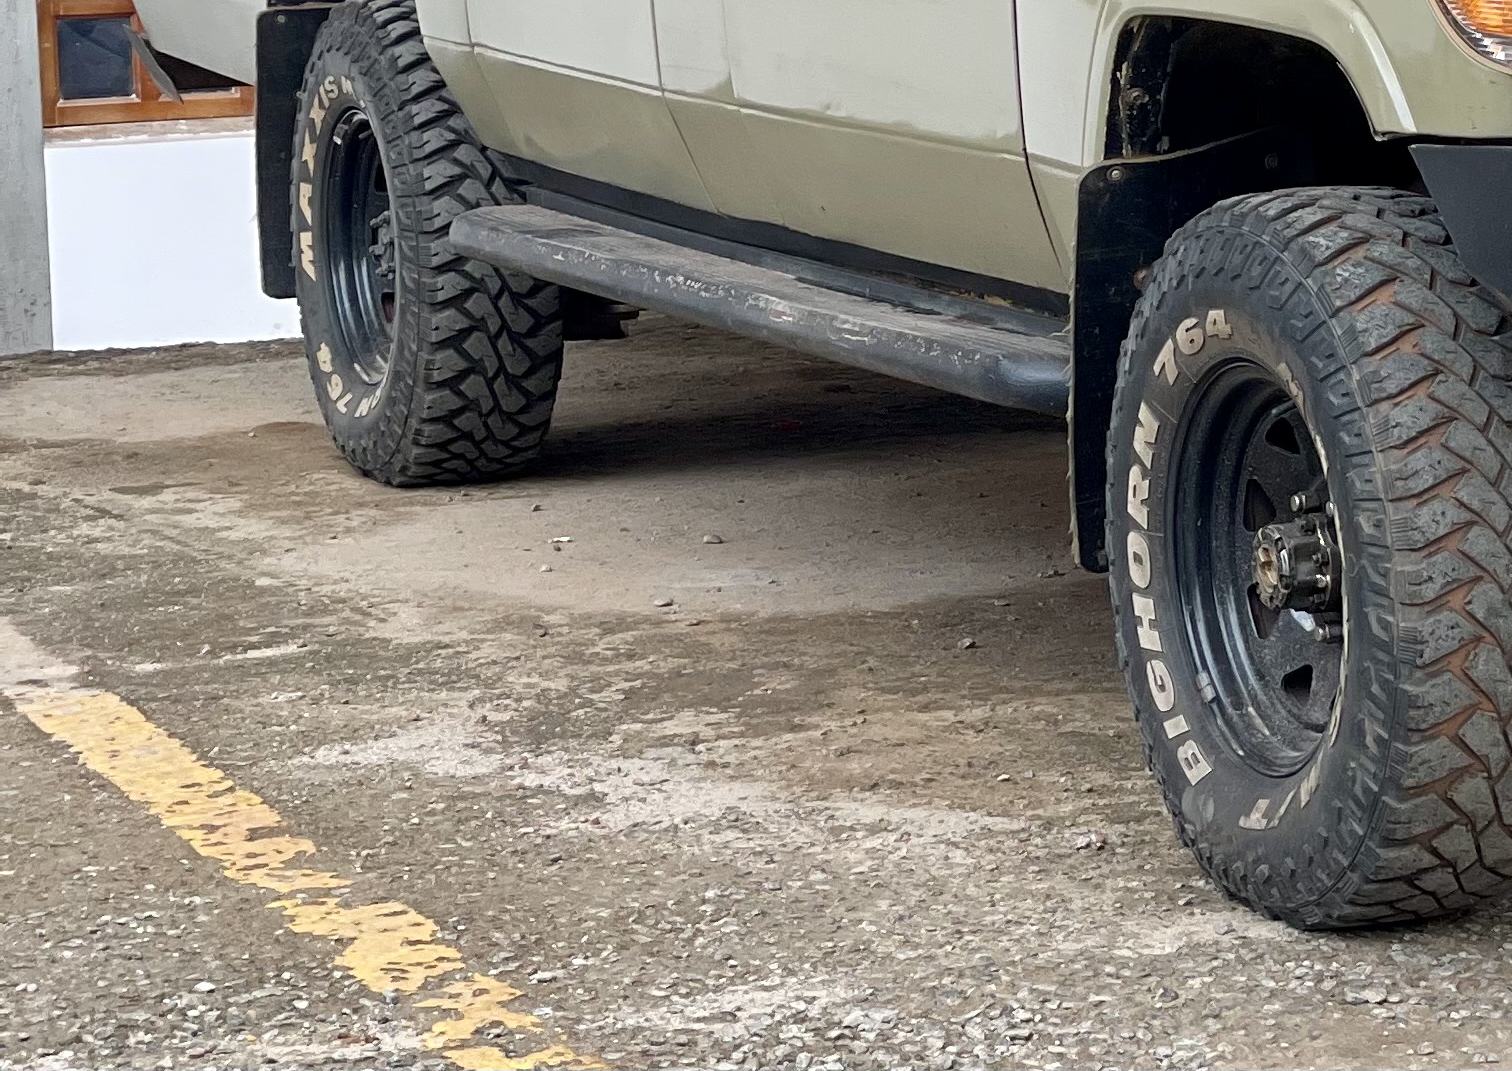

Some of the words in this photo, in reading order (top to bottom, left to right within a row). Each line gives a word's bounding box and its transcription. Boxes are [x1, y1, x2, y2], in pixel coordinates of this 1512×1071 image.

[299, 74, 339, 283] MAXXIS
[1153, 308, 1232, 390] 764
[1127, 401, 1214, 786] BIGHORN
